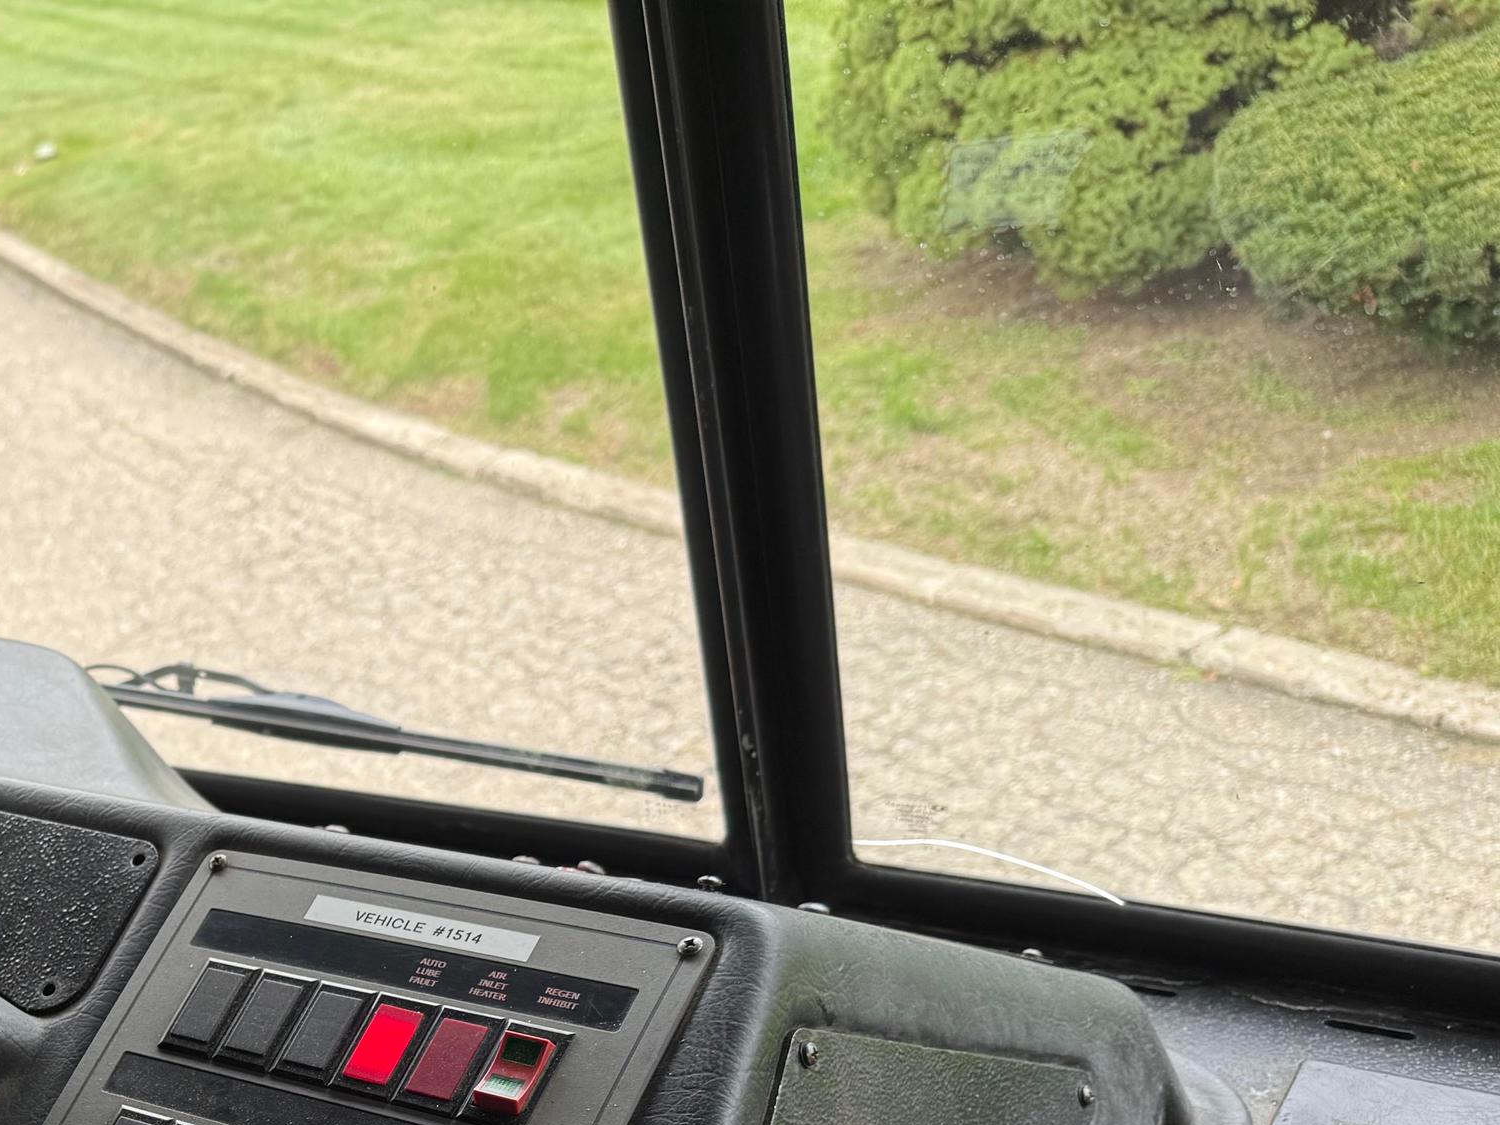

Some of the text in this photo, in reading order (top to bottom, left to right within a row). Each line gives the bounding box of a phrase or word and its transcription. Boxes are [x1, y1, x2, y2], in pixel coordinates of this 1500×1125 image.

[356, 910, 483, 944] VEHICLE #1514
[419, 957, 446, 970] AUTO
[415, 967, 442, 979] LUBE
[488, 971, 508, 981] AIR
[409, 976, 438, 988] FAULT
[478, 979, 508, 990] INLET
[469, 988, 507, 1001] HEATER
[545, 987, 580, 1000] REGEN
[537, 996, 579, 1010] INHIBIT
